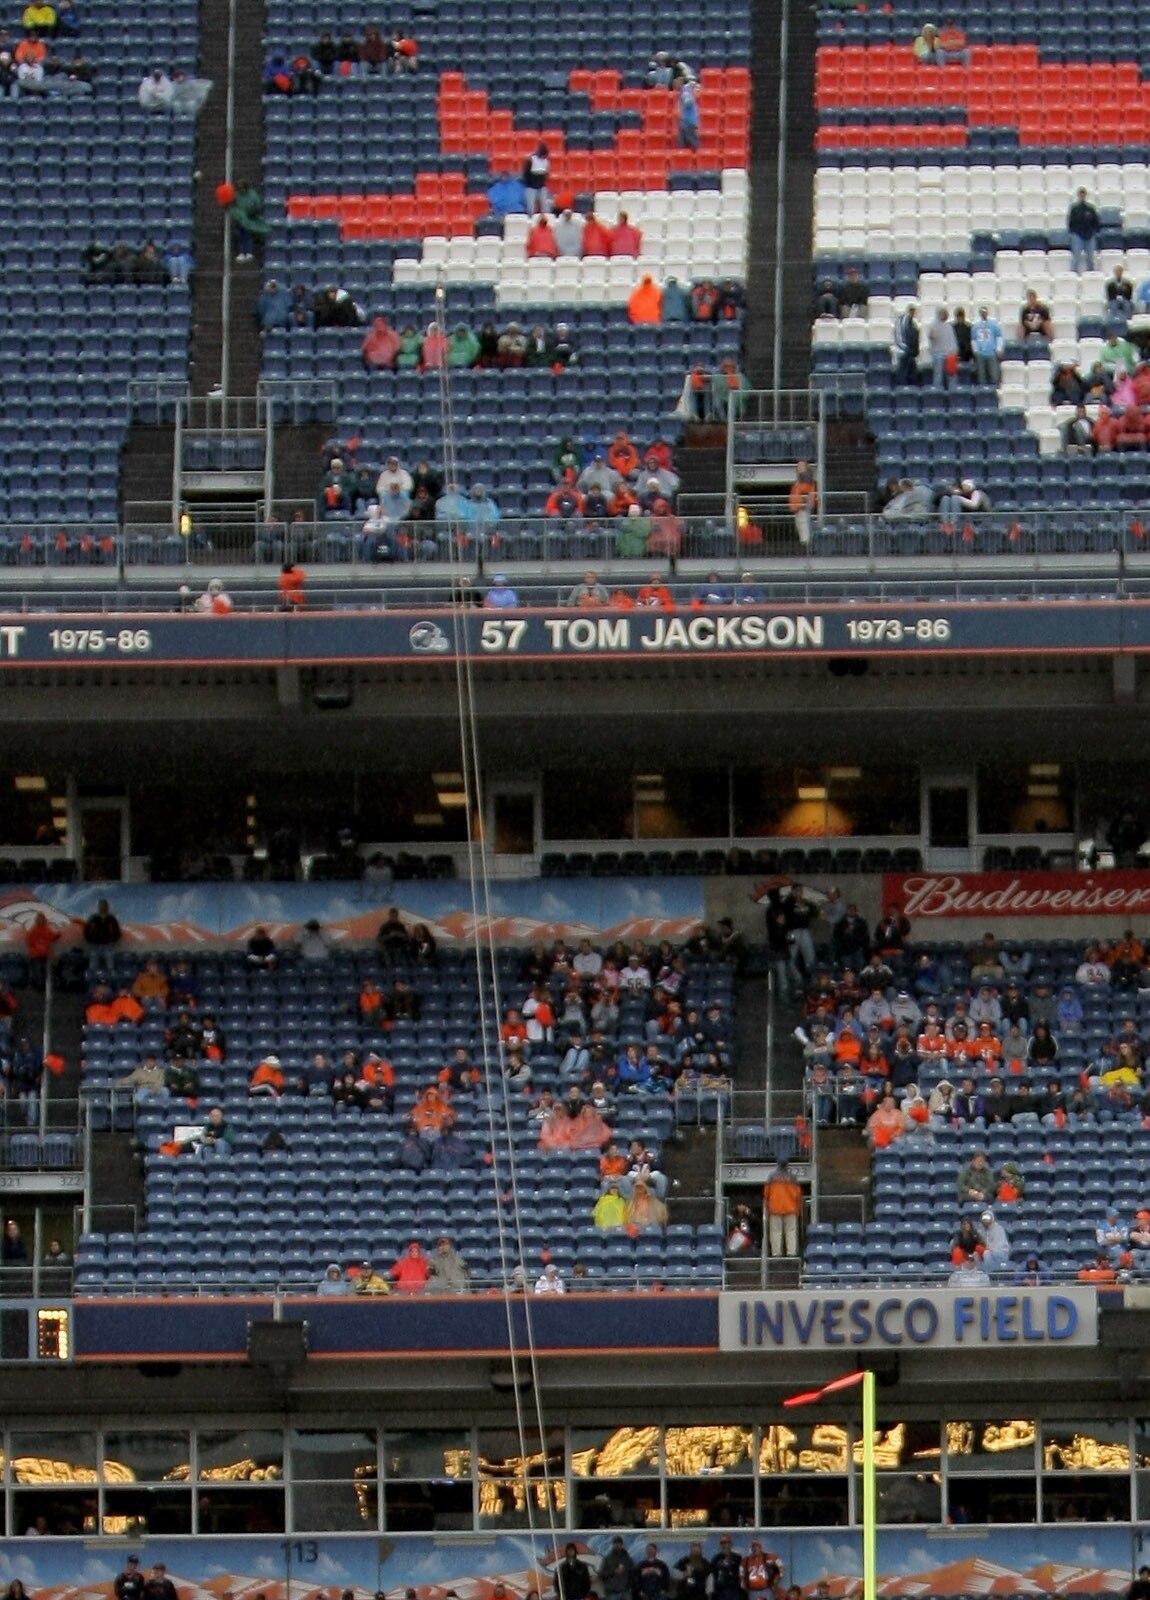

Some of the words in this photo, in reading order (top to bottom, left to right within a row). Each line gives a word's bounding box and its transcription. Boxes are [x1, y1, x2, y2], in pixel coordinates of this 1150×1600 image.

[49, 630, 150, 652] 1975-86
[480, 619, 527, 650] 57
[544, 619, 628, 650] TOM
[641, 616, 824, 649] JACKSON
[846, 619, 950, 642] 1973-86
[903, 876, 1150, 914] Budweiser
[738, 1297, 938, 1344] INVESCO
[954, 1295, 1079, 1340] FIELD
[279, 1541, 319, 1563] 113
